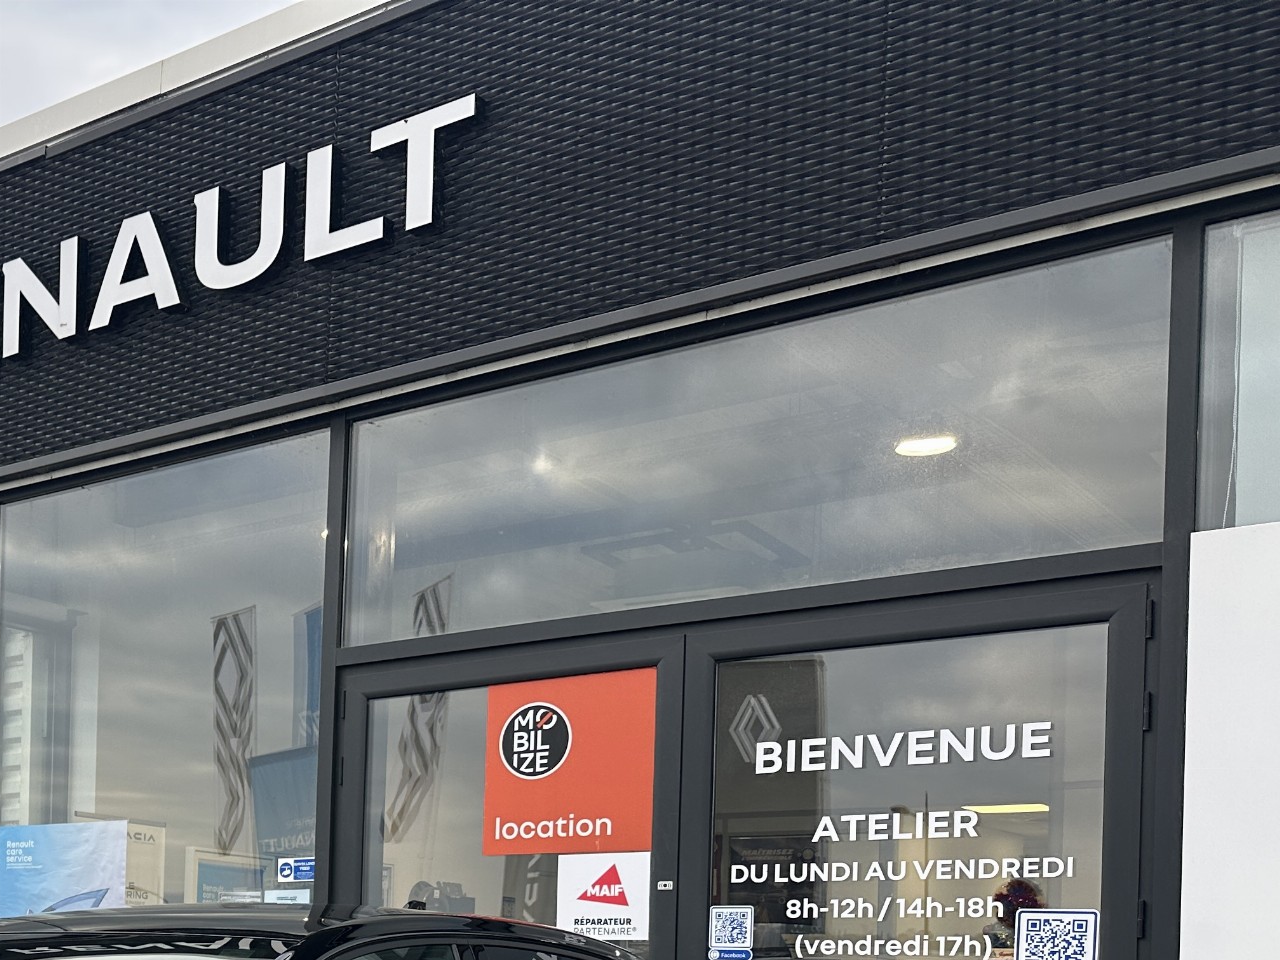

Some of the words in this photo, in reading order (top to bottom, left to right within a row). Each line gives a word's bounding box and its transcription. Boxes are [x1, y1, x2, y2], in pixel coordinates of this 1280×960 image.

[754, 721, 1052, 775] BIENVENUE
[494, 813, 613, 841] location
[811, 810, 979, 843] ATELIER
[6, 839, 35, 848] Renault
[6, 848, 23, 856] care
[6, 855, 33, 863] service
[730, 863, 769, 884] DU
[774, 861, 858, 884] LUNDI
[864, 860, 907, 882] AU
[912, 856, 1075, 881] VENDREDI
[586, 883, 624, 897] MAIF
[573, 915, 632, 926] RÉPARATEUR
[785, 899, 874, 919] 8h-12h
[877, 897, 891, 921] /
[898, 896, 1004, 918] 14h-18h
[794, 934, 929, 959] (vendredi
[936, 935, 992, 960] 17h)
